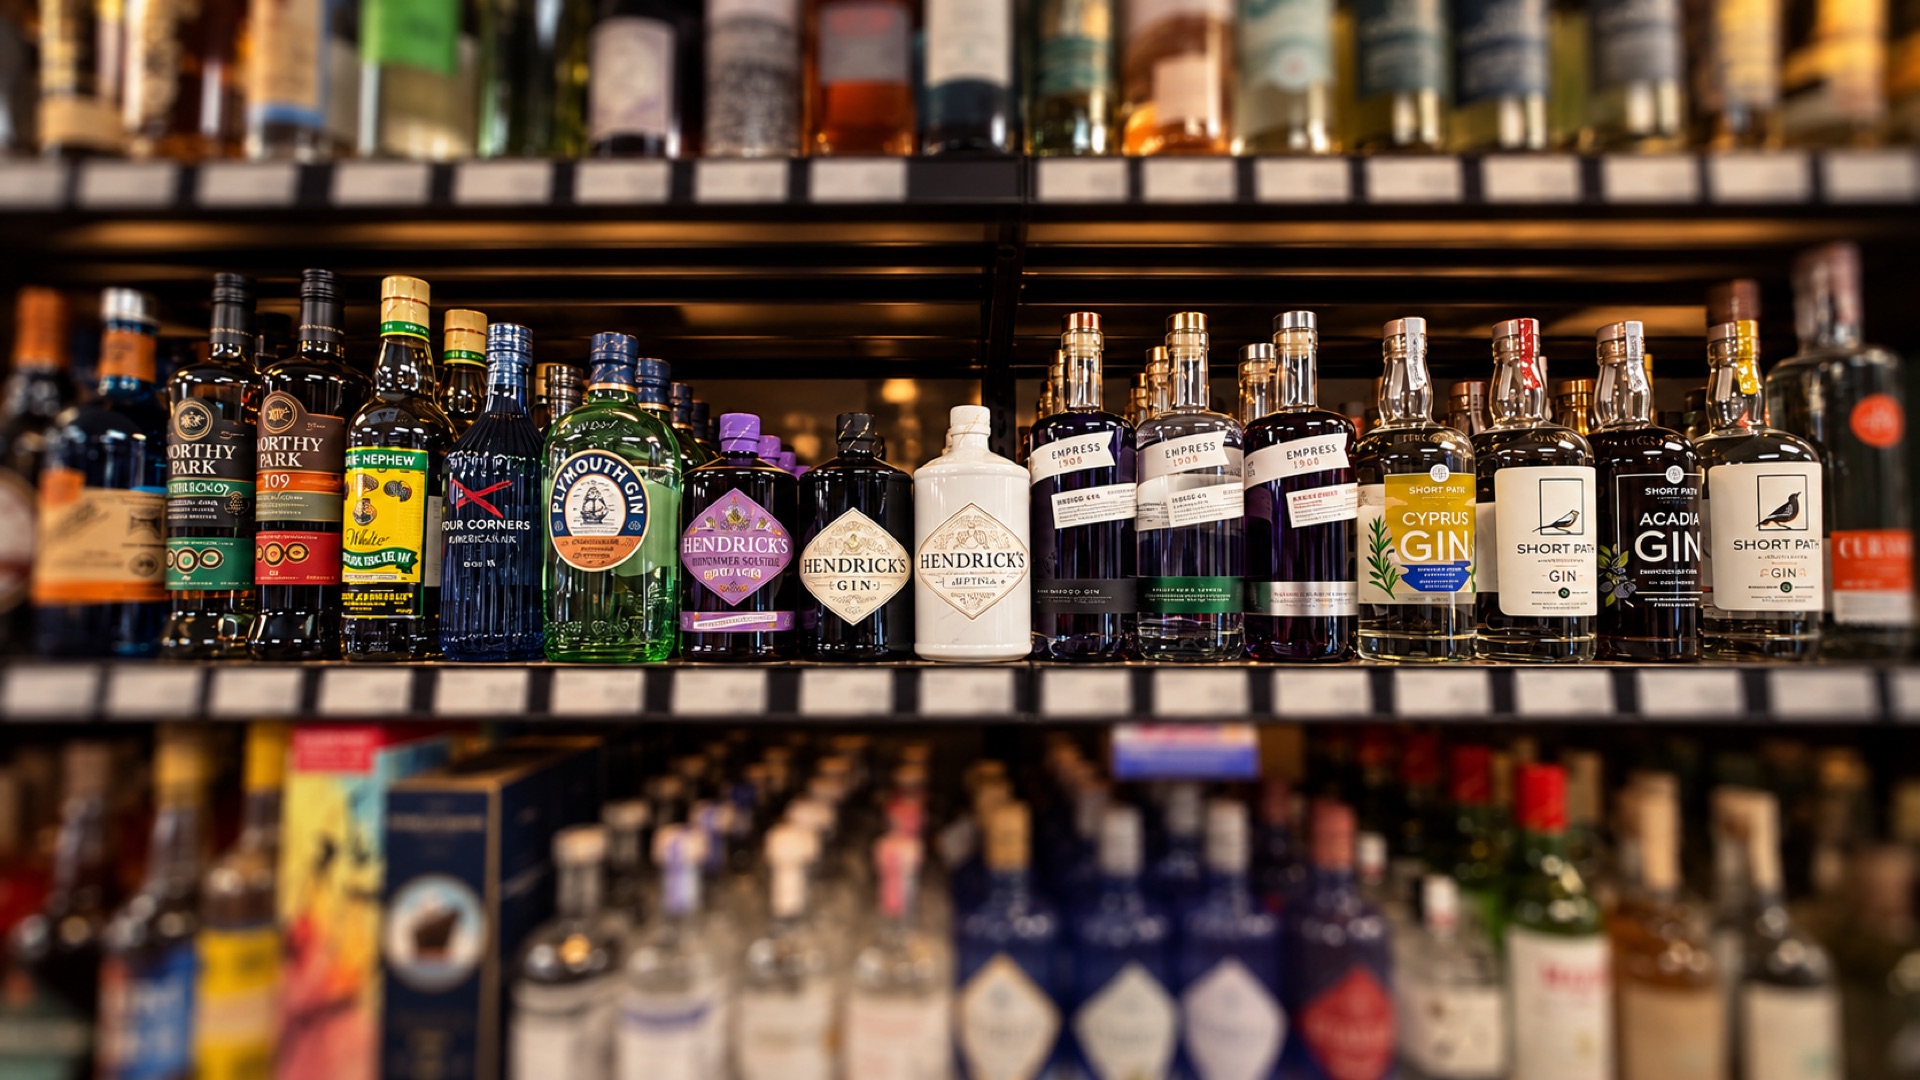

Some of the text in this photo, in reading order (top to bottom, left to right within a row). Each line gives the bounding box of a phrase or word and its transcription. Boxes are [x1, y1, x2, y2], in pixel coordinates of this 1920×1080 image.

[1051, 442, 1101, 460] EMPRESS
[1165, 441, 1216, 459] EMPRESS
[1286, 443, 1337, 460] EMPRESS
[172, 460, 217, 475] PARK
[260, 452, 302, 468] PARK
[362, 453, 416, 467] NEPHEW
[263, 473, 290, 489] 109
[552, 457, 644, 514] PLYMOUTH GIN
[1409, 486, 1443, 495] SHORT
[1644, 487, 1679, 496] SHORT
[441, 519, 531, 531] FOUR CORNERS
[1402, 511, 1469, 526] CYPRUS
[1639, 512, 1700, 527] ACADIA
[683, 536, 789, 554] HENDRICK'S
[1400, 530, 1469, 562] GIN
[1517, 543, 1571, 554] SHORT
[1634, 530, 1701, 563] GIN
[1733, 539, 1791, 551] SHORT
[803, 557, 906, 574] HENDRICK'S
[920, 551, 1025, 569] HENDRICK'S
[1549, 569, 1577, 583] GIN
[1771, 568, 1797, 578] GIN
[836, 580, 871, 591] GIN
